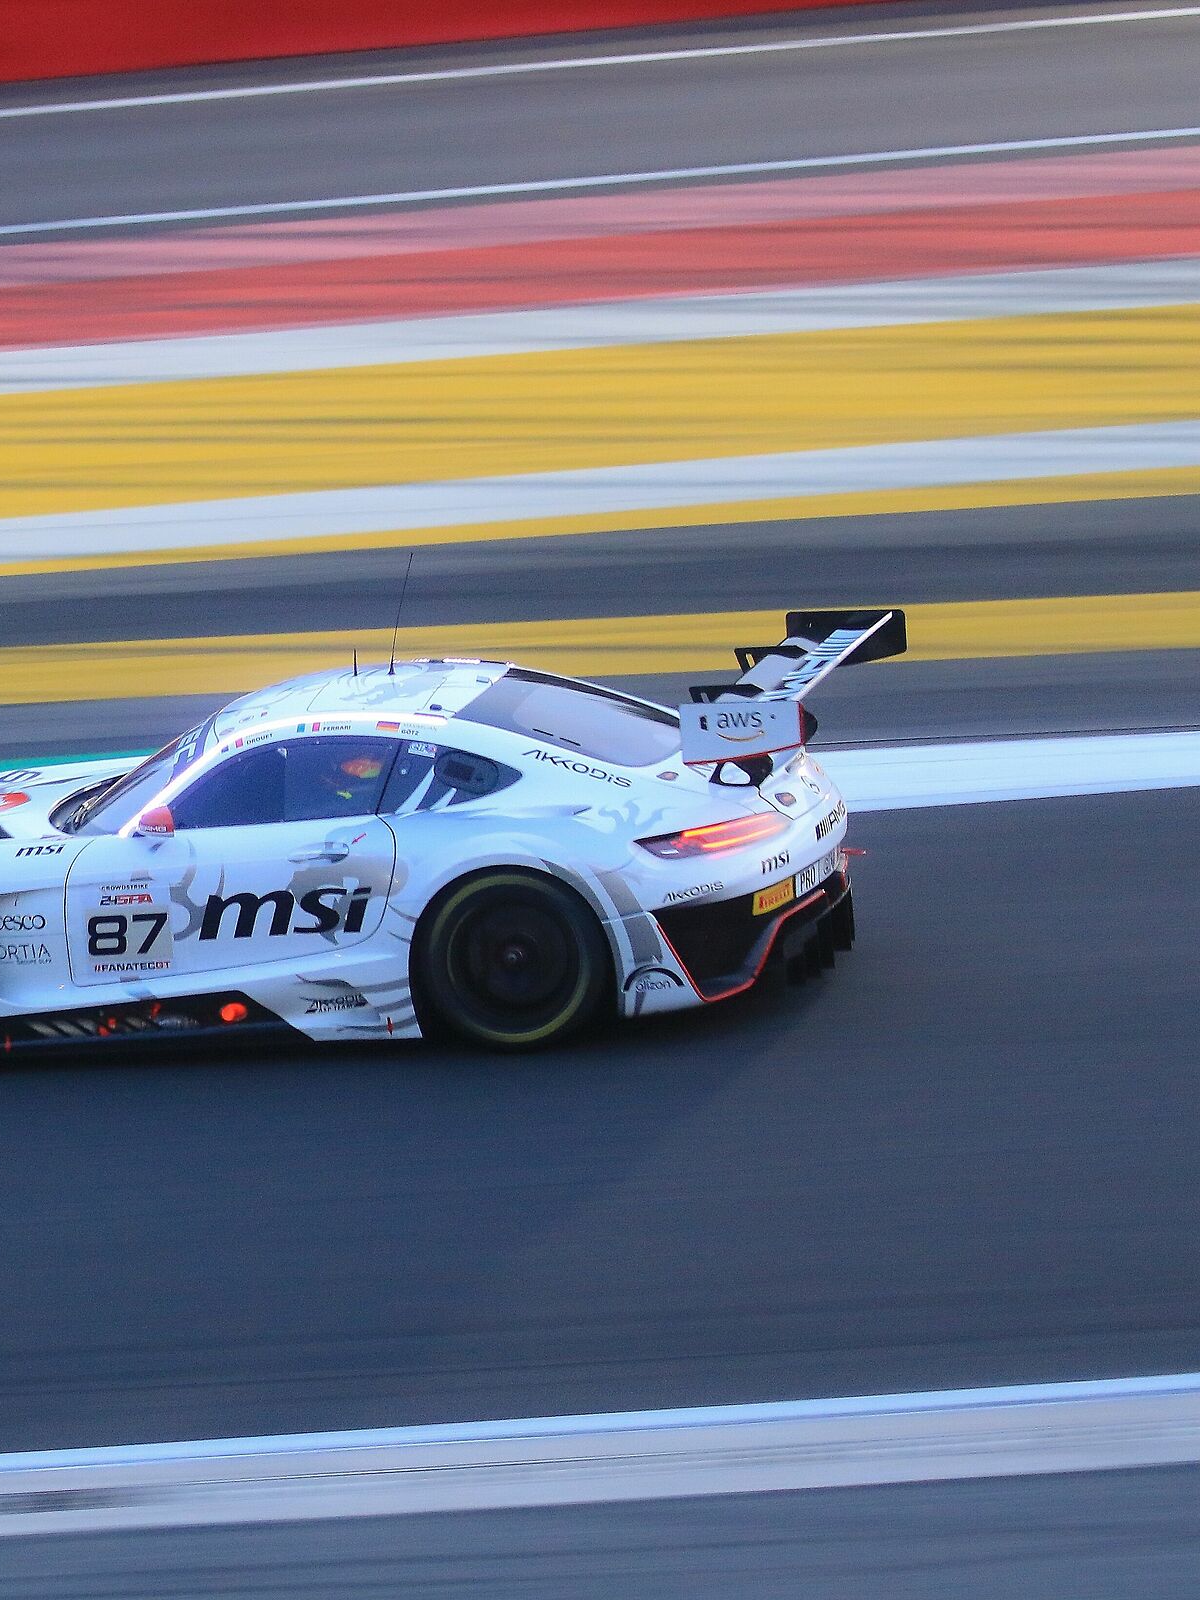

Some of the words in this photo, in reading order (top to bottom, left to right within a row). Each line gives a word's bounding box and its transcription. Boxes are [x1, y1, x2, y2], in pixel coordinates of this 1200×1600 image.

[717, 711, 763, 729] aws
[15, 844, 66, 857] msi
[761, 850, 790, 875] msi
[800, 863, 815, 893] PRO
[199, 887, 372, 941] msi
[87, 912, 168, 956] 87
